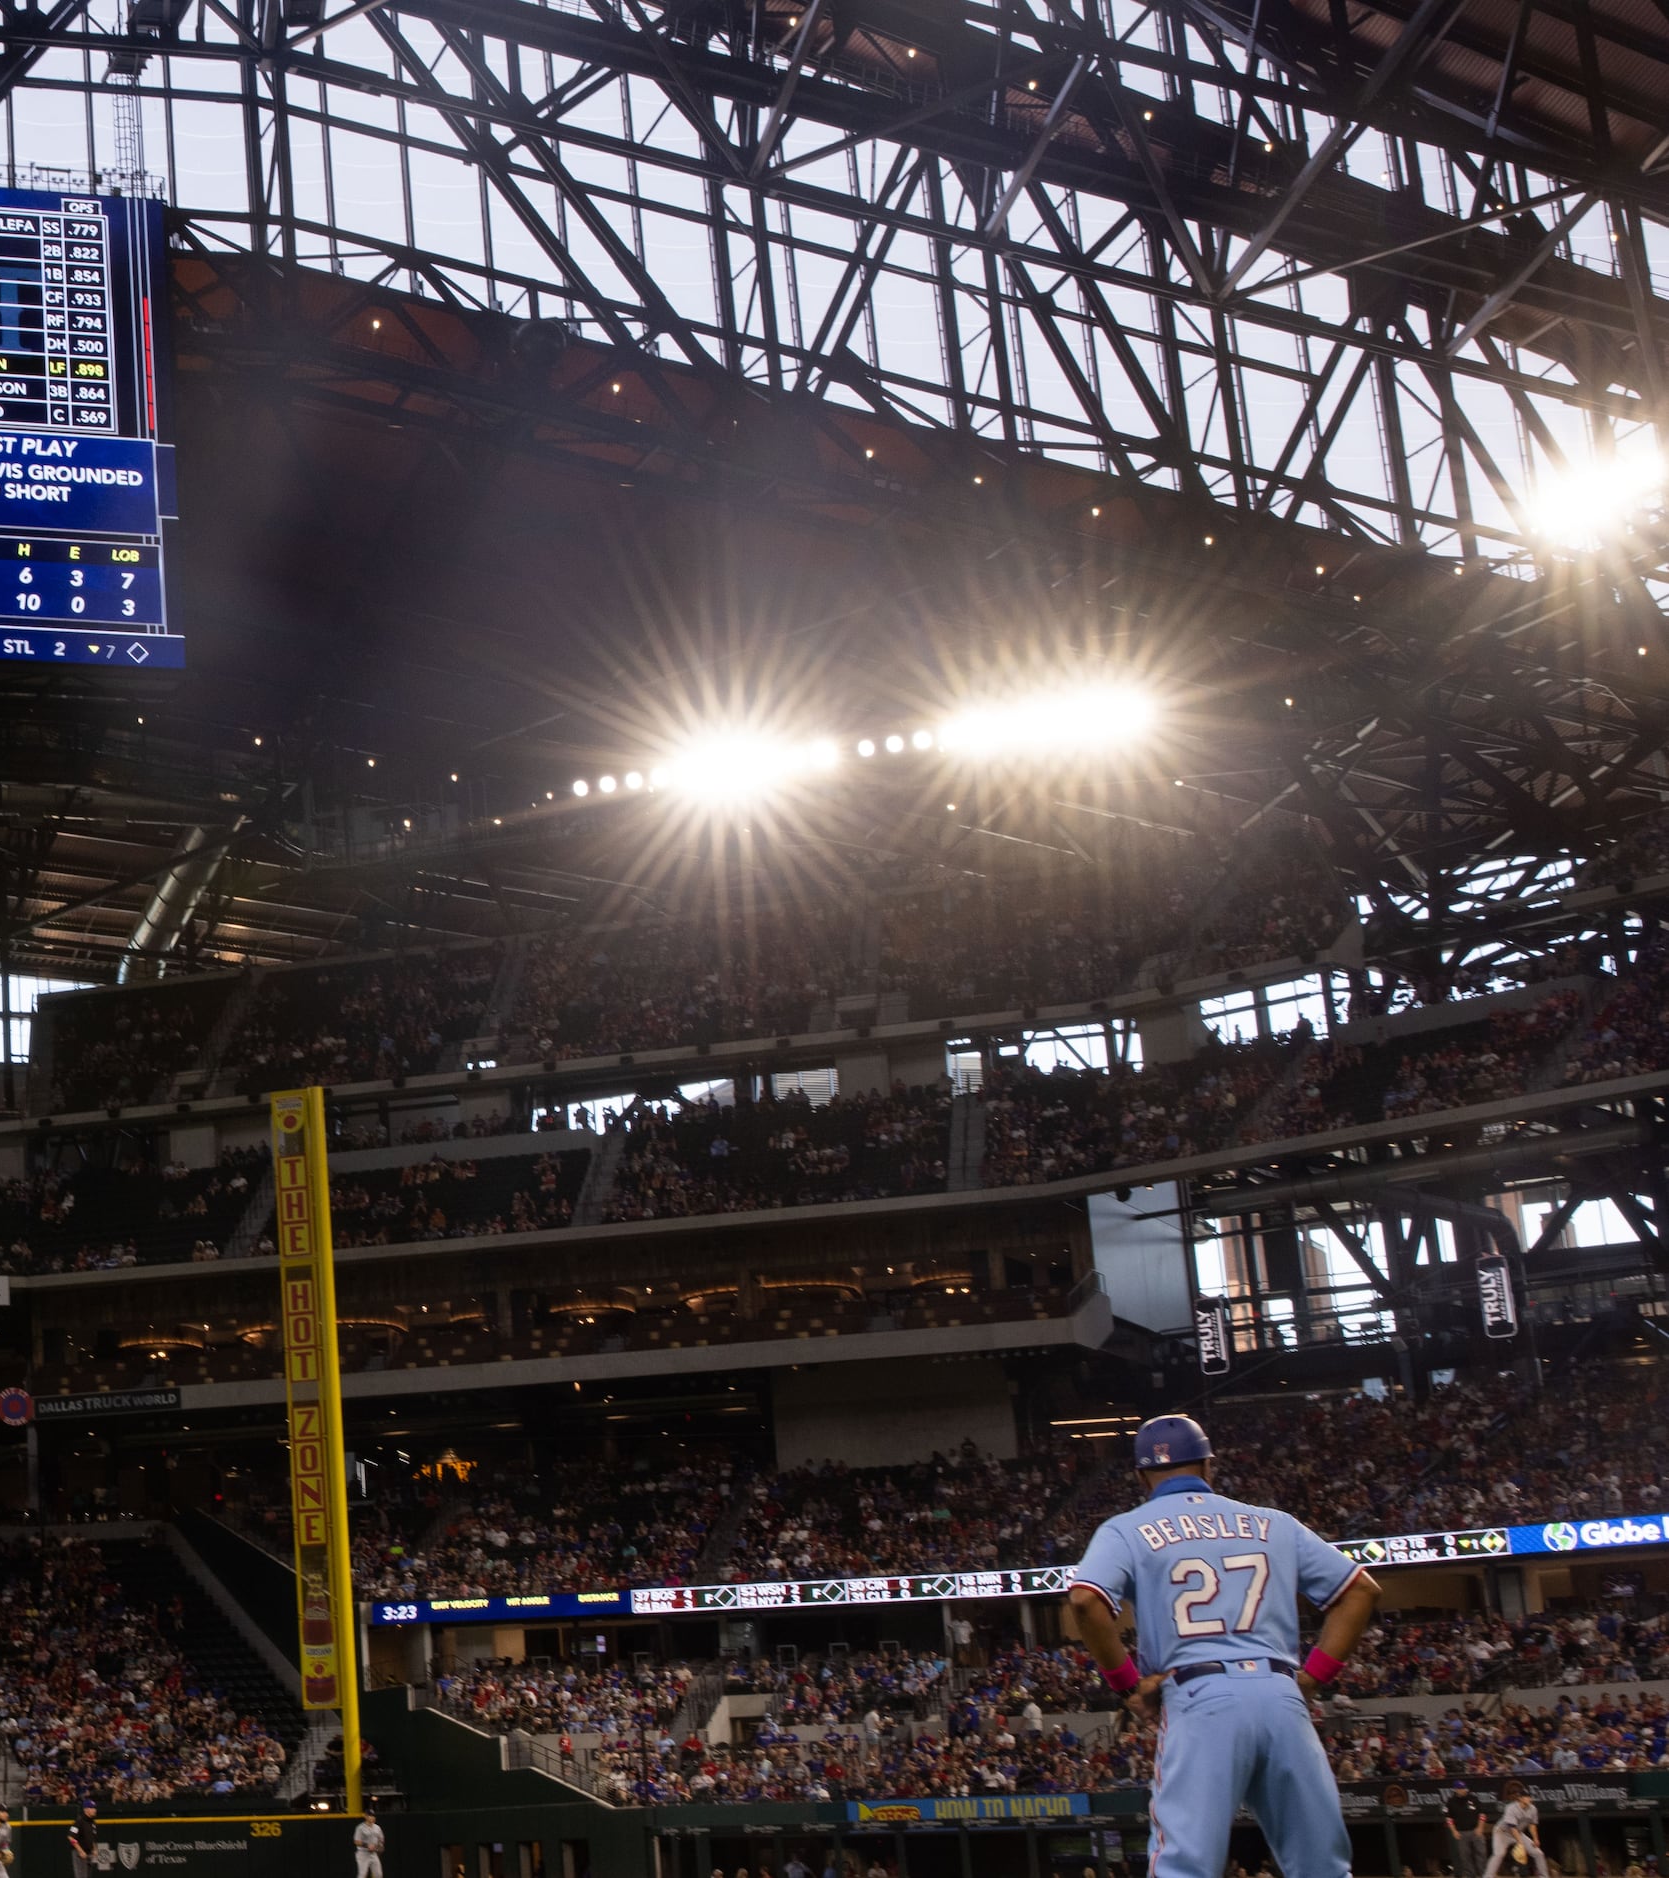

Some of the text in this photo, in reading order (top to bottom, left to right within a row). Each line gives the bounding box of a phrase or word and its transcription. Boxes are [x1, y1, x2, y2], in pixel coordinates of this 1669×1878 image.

[69, 203, 94, 214] OPS
[21, 437, 78, 458] PLAY
[28, 464, 143, 486] GROUNDED
[4, 483, 71, 503] SHORT
[279, 1158, 306, 1252] THE
[1479, 1269, 1503, 1327] TRULY
[289, 1283, 314, 1380] HOT
[1196, 1310, 1218, 1364] TRULY
[38, 1393, 177, 1413] DALLAS TRUCK WORLD
[296, 1410, 320, 1542] ZONE
[1137, 1512, 1272, 1552] BEASLEY
[1580, 1522, 1661, 1546] Globe
[1170, 1551, 1269, 1640] 27
[383, 1605, 417, 1620] 3:23
[250, 1822, 282, 1839] 326
[145, 1840, 247, 1852] BlueCross BlueShield
[145, 1854, 187, 1865] of Texas
